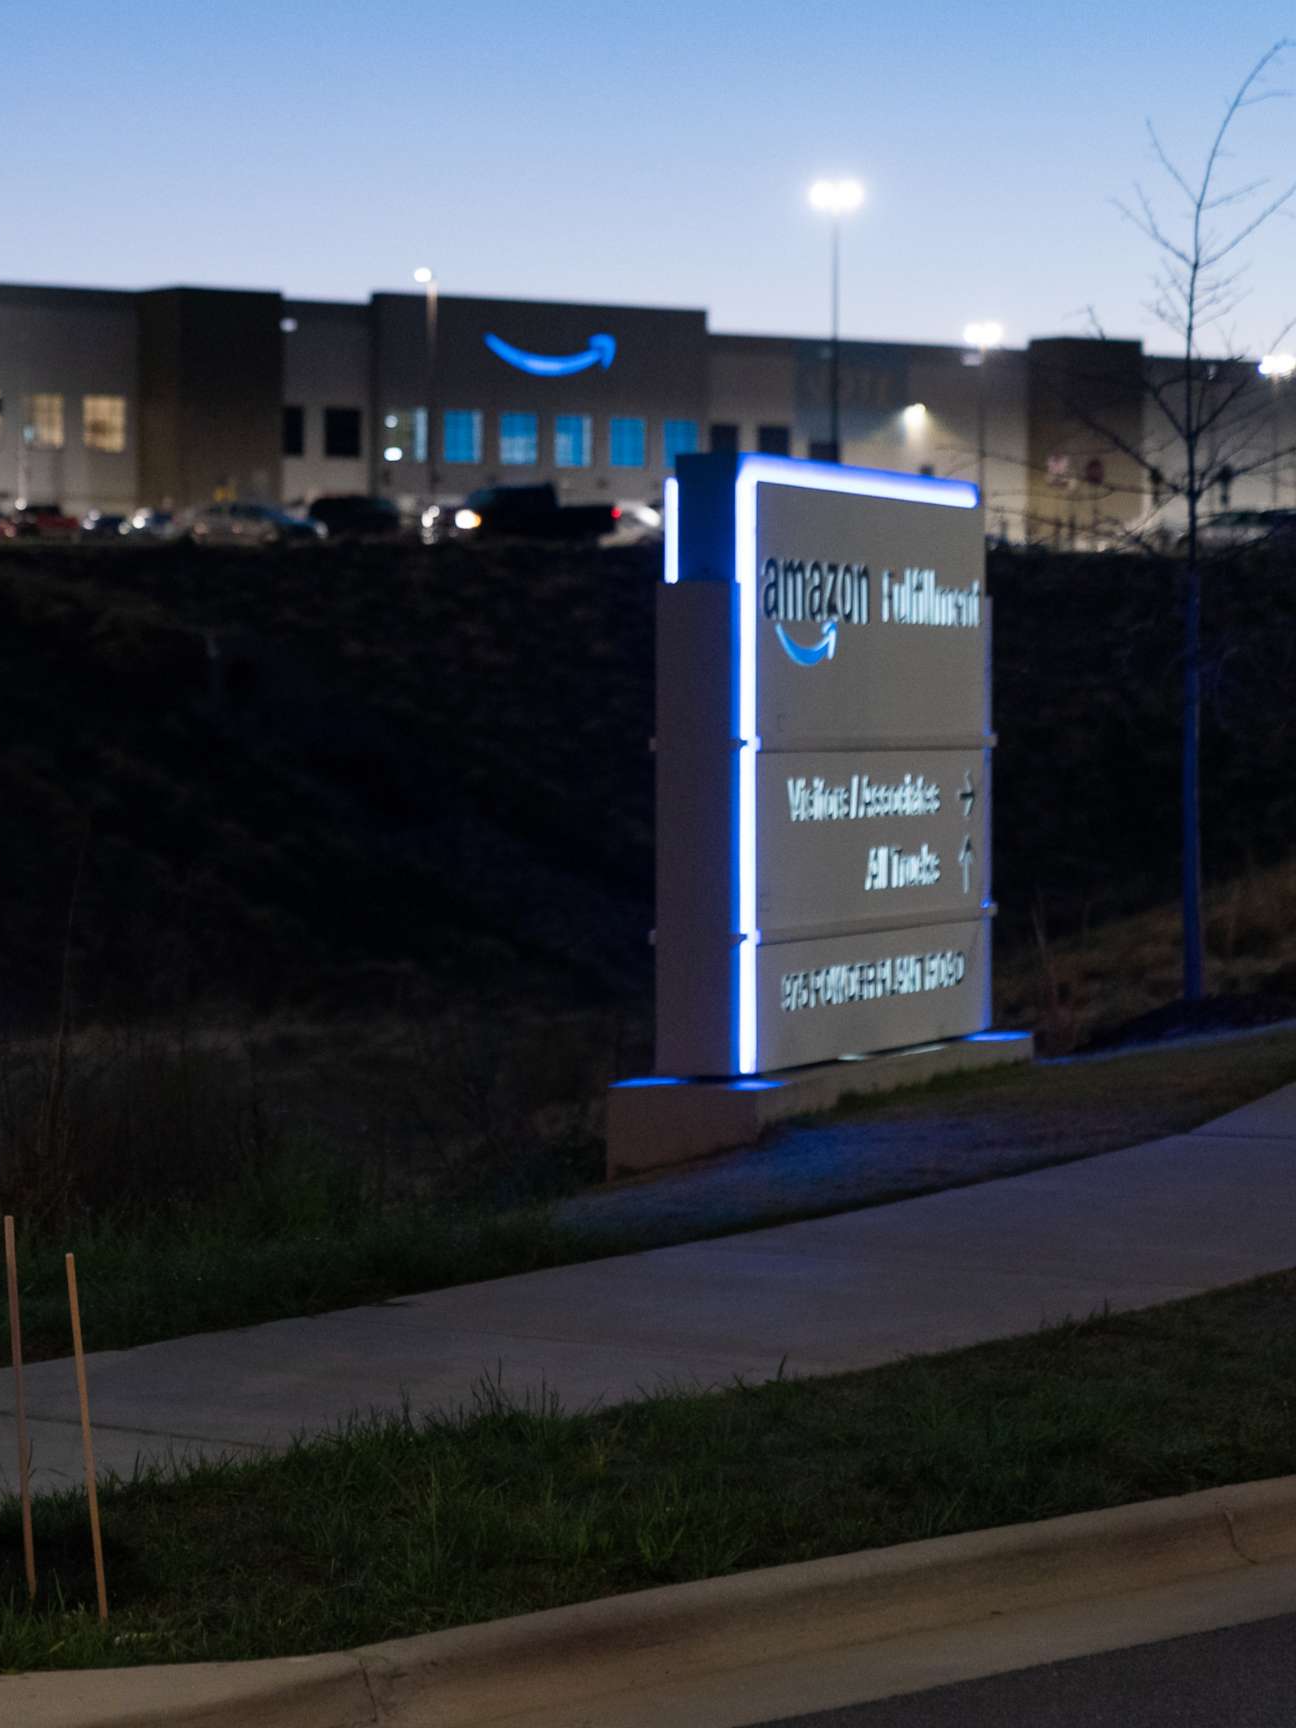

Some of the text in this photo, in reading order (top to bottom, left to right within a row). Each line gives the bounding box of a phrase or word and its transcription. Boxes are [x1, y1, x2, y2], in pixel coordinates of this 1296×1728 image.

[762, 557, 982, 627] amazon Fulfillment
[787, 777, 848, 821] Visitors
[858, 774, 940, 818] Associates
[864, 845, 940, 890] All Trucks
[781, 949, 966, 1012] 975 POWDER PLANT ROAD
